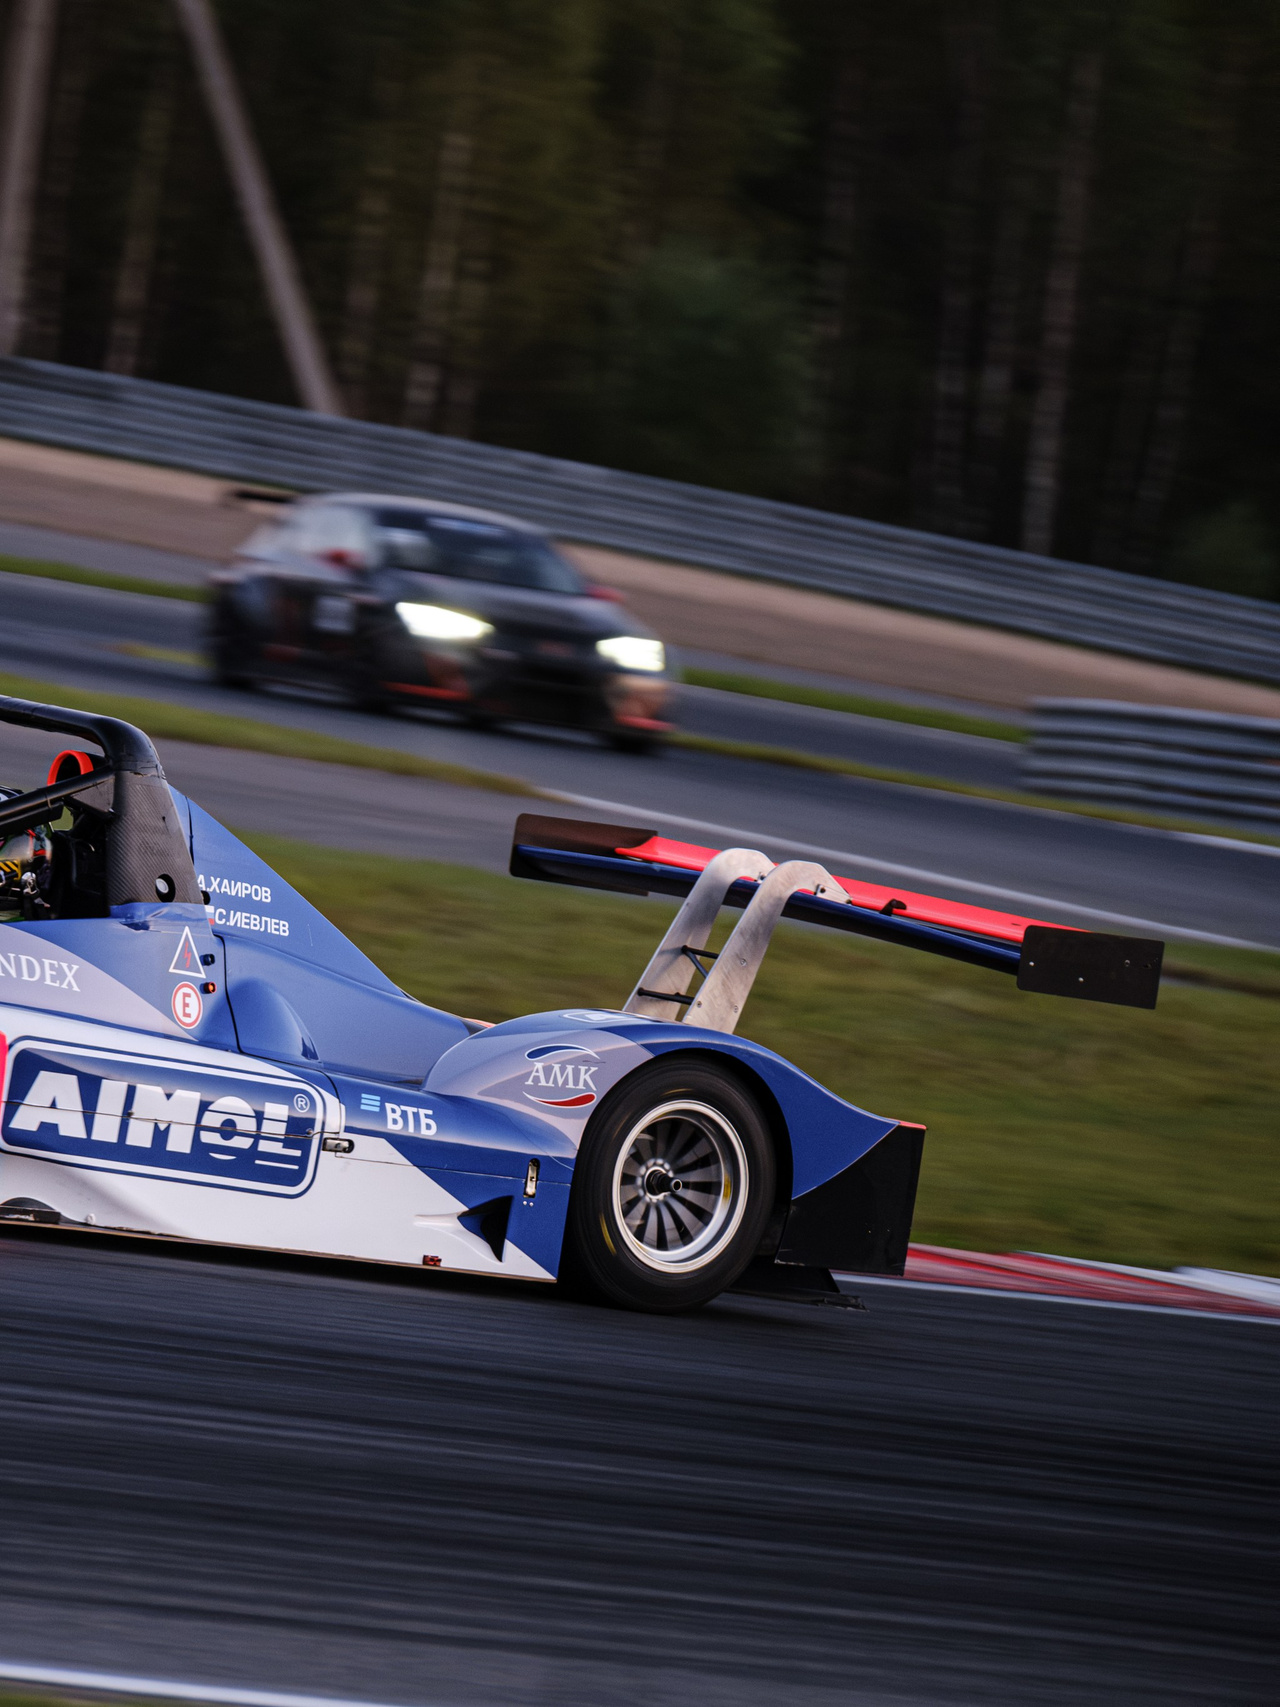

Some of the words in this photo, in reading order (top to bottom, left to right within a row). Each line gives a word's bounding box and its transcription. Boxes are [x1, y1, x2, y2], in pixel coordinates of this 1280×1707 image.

[215, 908, 290, 937] С.ИЕВЛЕВ
[182, 992, 192, 1019] E
[385, 1102, 438, 1136] ВТБ
